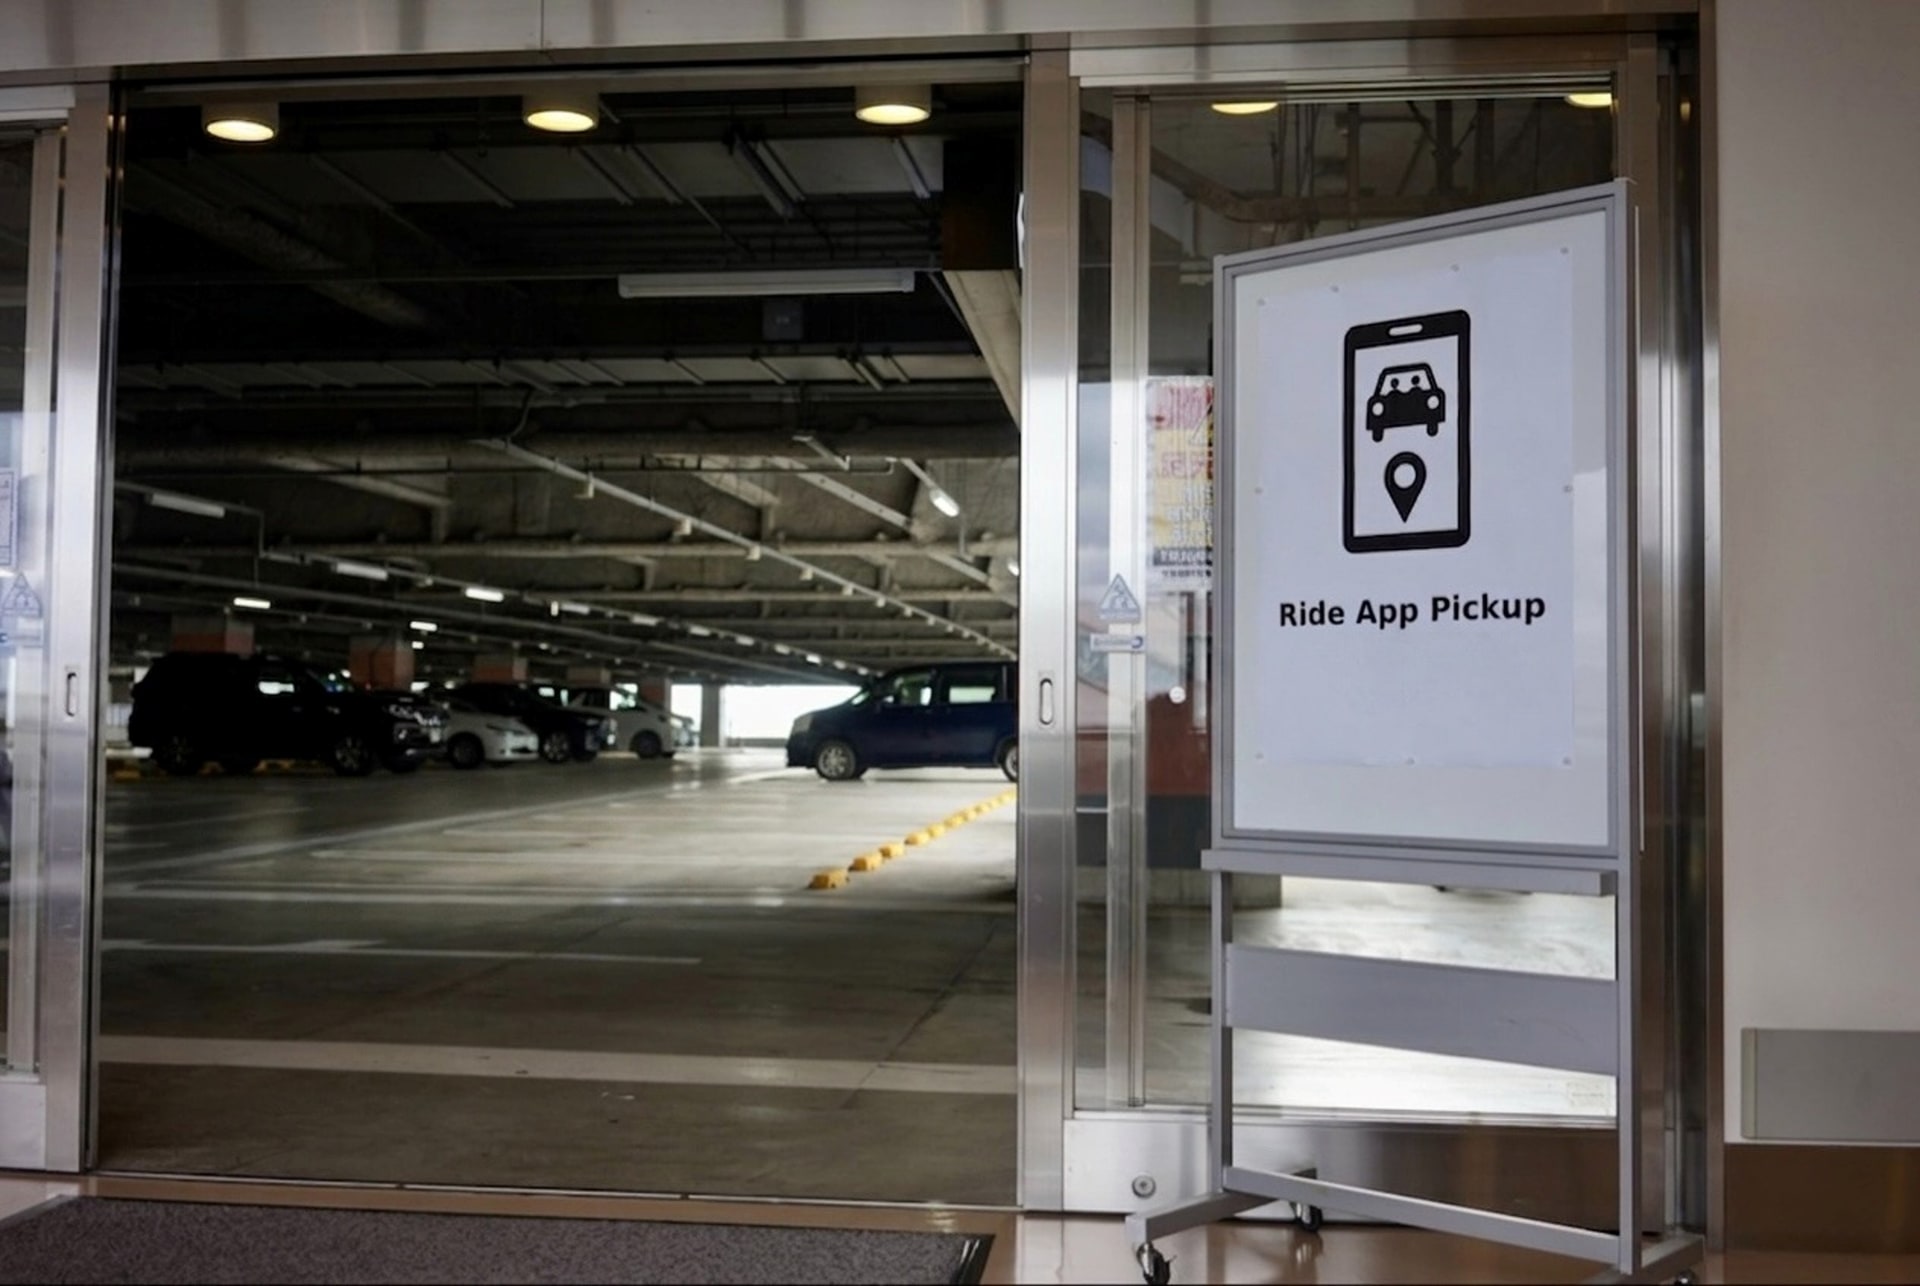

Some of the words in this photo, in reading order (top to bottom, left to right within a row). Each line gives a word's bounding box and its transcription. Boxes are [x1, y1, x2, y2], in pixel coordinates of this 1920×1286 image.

[1279, 599, 1345, 627] Ride
[1355, 599, 1419, 630] App
[1431, 592, 1546, 625] Pickup
